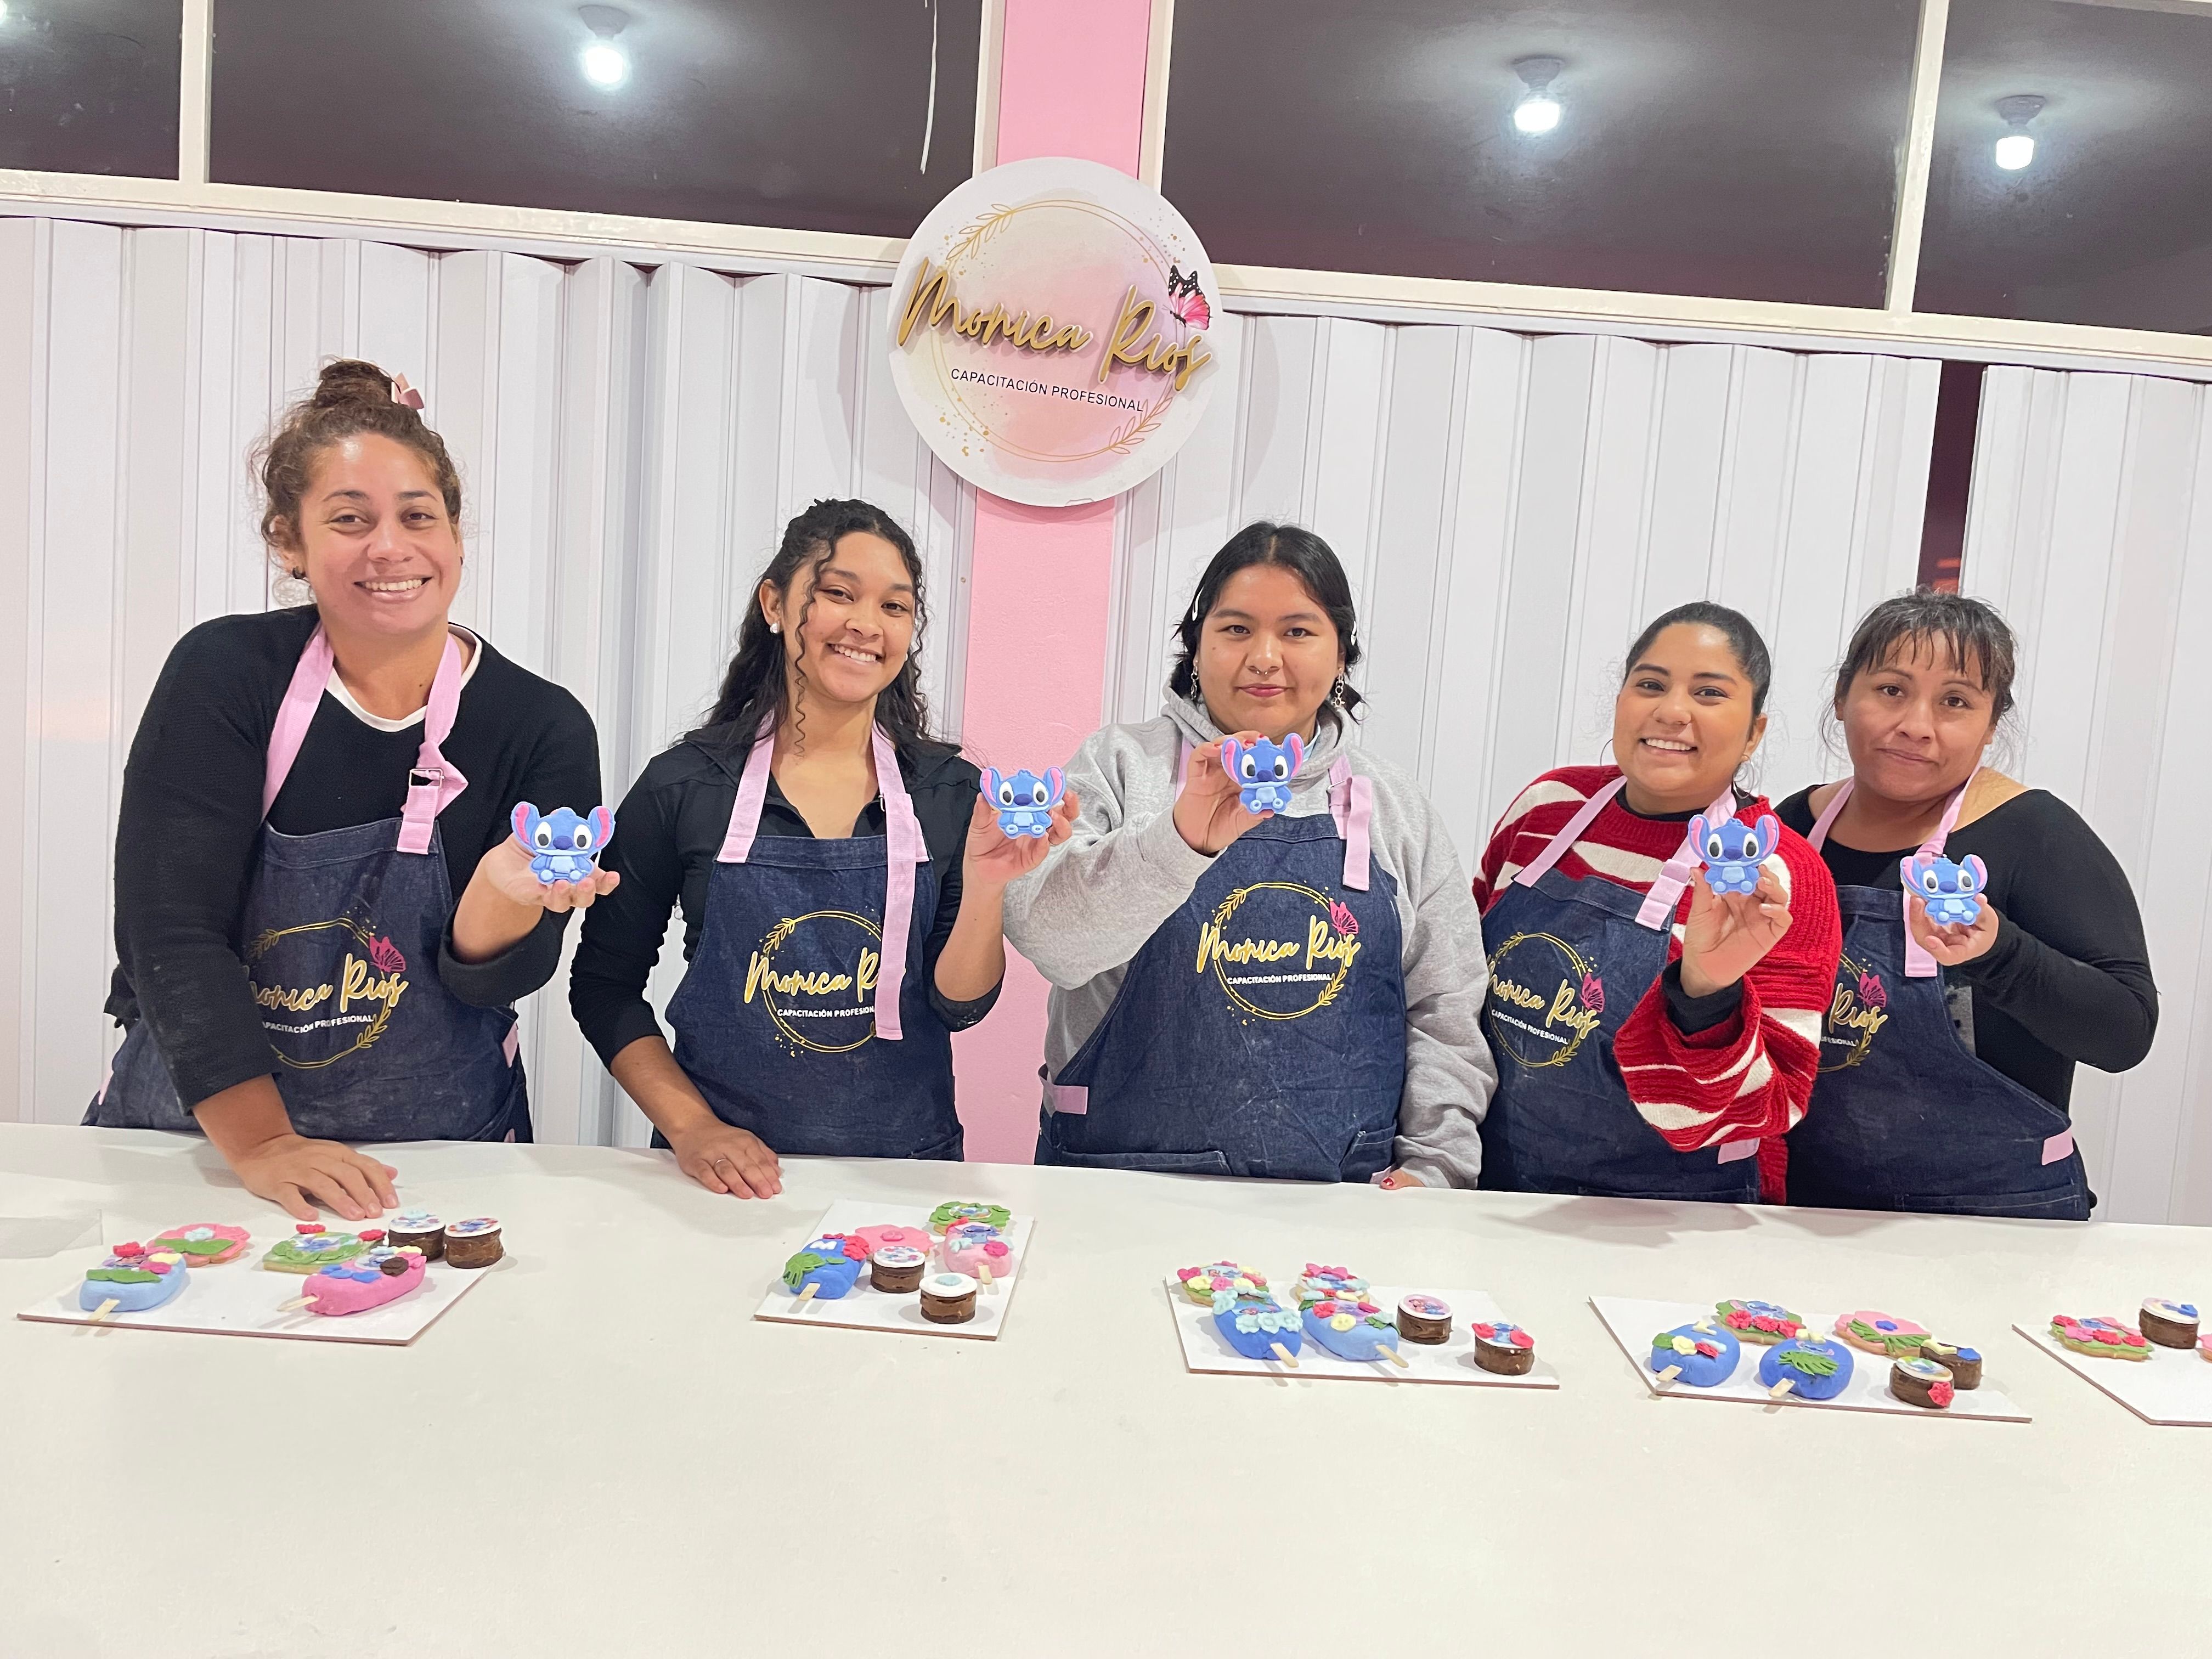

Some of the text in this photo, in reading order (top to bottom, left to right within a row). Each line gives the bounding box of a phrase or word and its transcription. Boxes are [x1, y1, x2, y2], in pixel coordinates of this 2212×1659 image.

[896, 256, 1211, 392] Monica Rios
[951, 368, 1144, 412] CAPACITACIÓN PROFESIONAL
[1197, 915, 1362, 974] Monica Rios
[340, 953, 409, 1013] Rios
[744, 951, 853, 1003] Monica
[1227, 973, 1332, 985] CAPACITACIÓN PROFESIONAL
[314, 1014, 374, 1029] PROFESIONAL
[777, 1005, 875, 1018] CAPACITACIÓN PROFESION
[1491, 1009, 1568, 1045] CAPACITACIÓN PROFESIONAL
[1545, 979, 1600, 1039] Rios
[1829, 983, 1888, 1034] Rios
